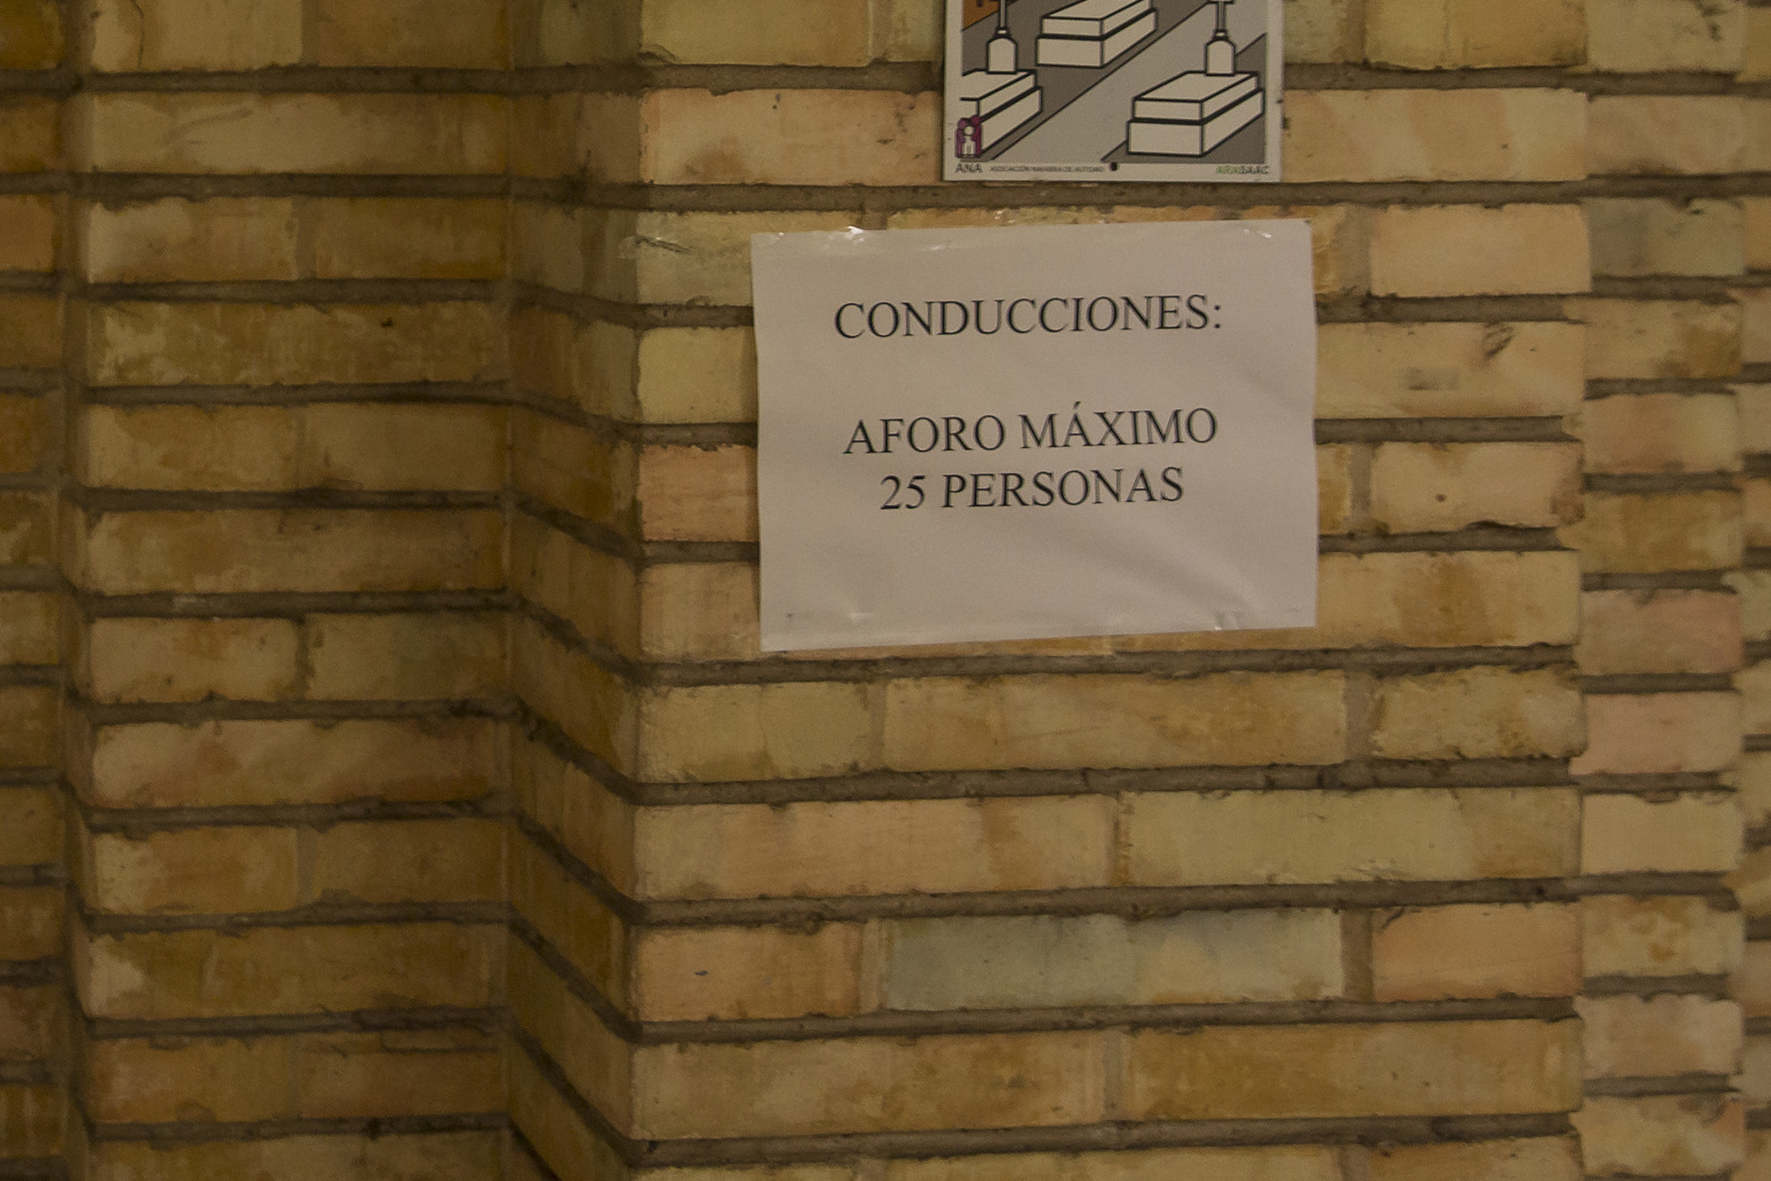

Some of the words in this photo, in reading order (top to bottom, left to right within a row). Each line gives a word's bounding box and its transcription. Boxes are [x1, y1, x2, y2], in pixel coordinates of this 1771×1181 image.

[834, 293, 1222, 339] CONDUCCIONES:
[843, 414, 1006, 454] AFORO
[1018, 401, 1219, 449] MÁXIMO
[880, 474, 926, 510] 25
[941, 466, 1184, 508] PERSONAS
